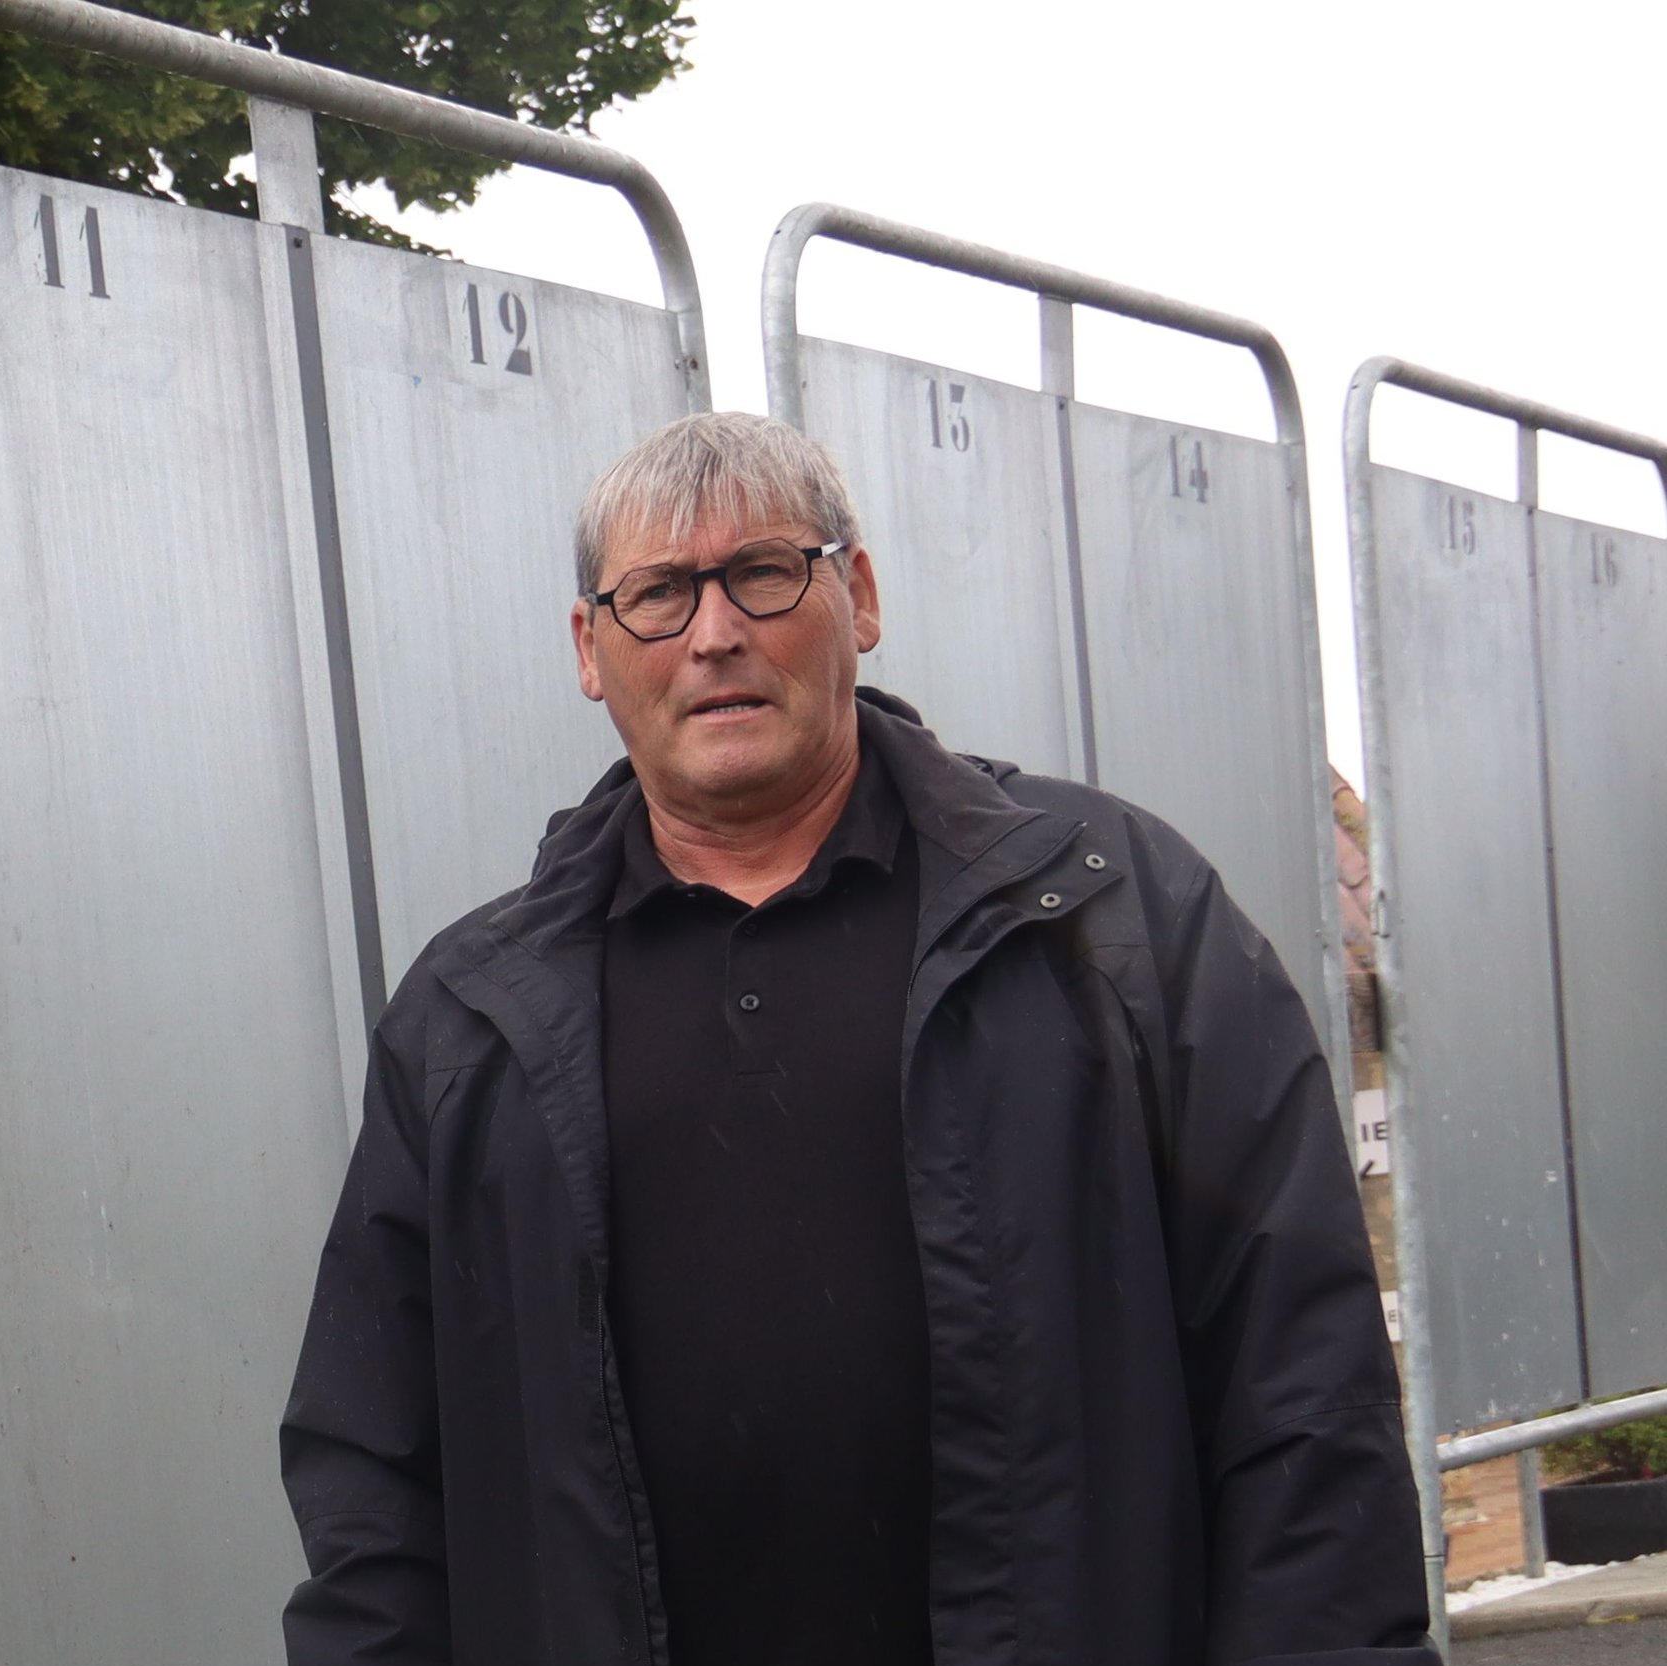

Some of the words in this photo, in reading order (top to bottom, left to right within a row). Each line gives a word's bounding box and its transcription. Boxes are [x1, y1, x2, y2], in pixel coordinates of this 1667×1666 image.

[33, 193, 112, 300] 11
[462, 282, 533, 377] 12
[924, 376, 970, 453] 13
[1167, 433, 1209, 504] 14
[1590, 532, 1619, 588] 16
